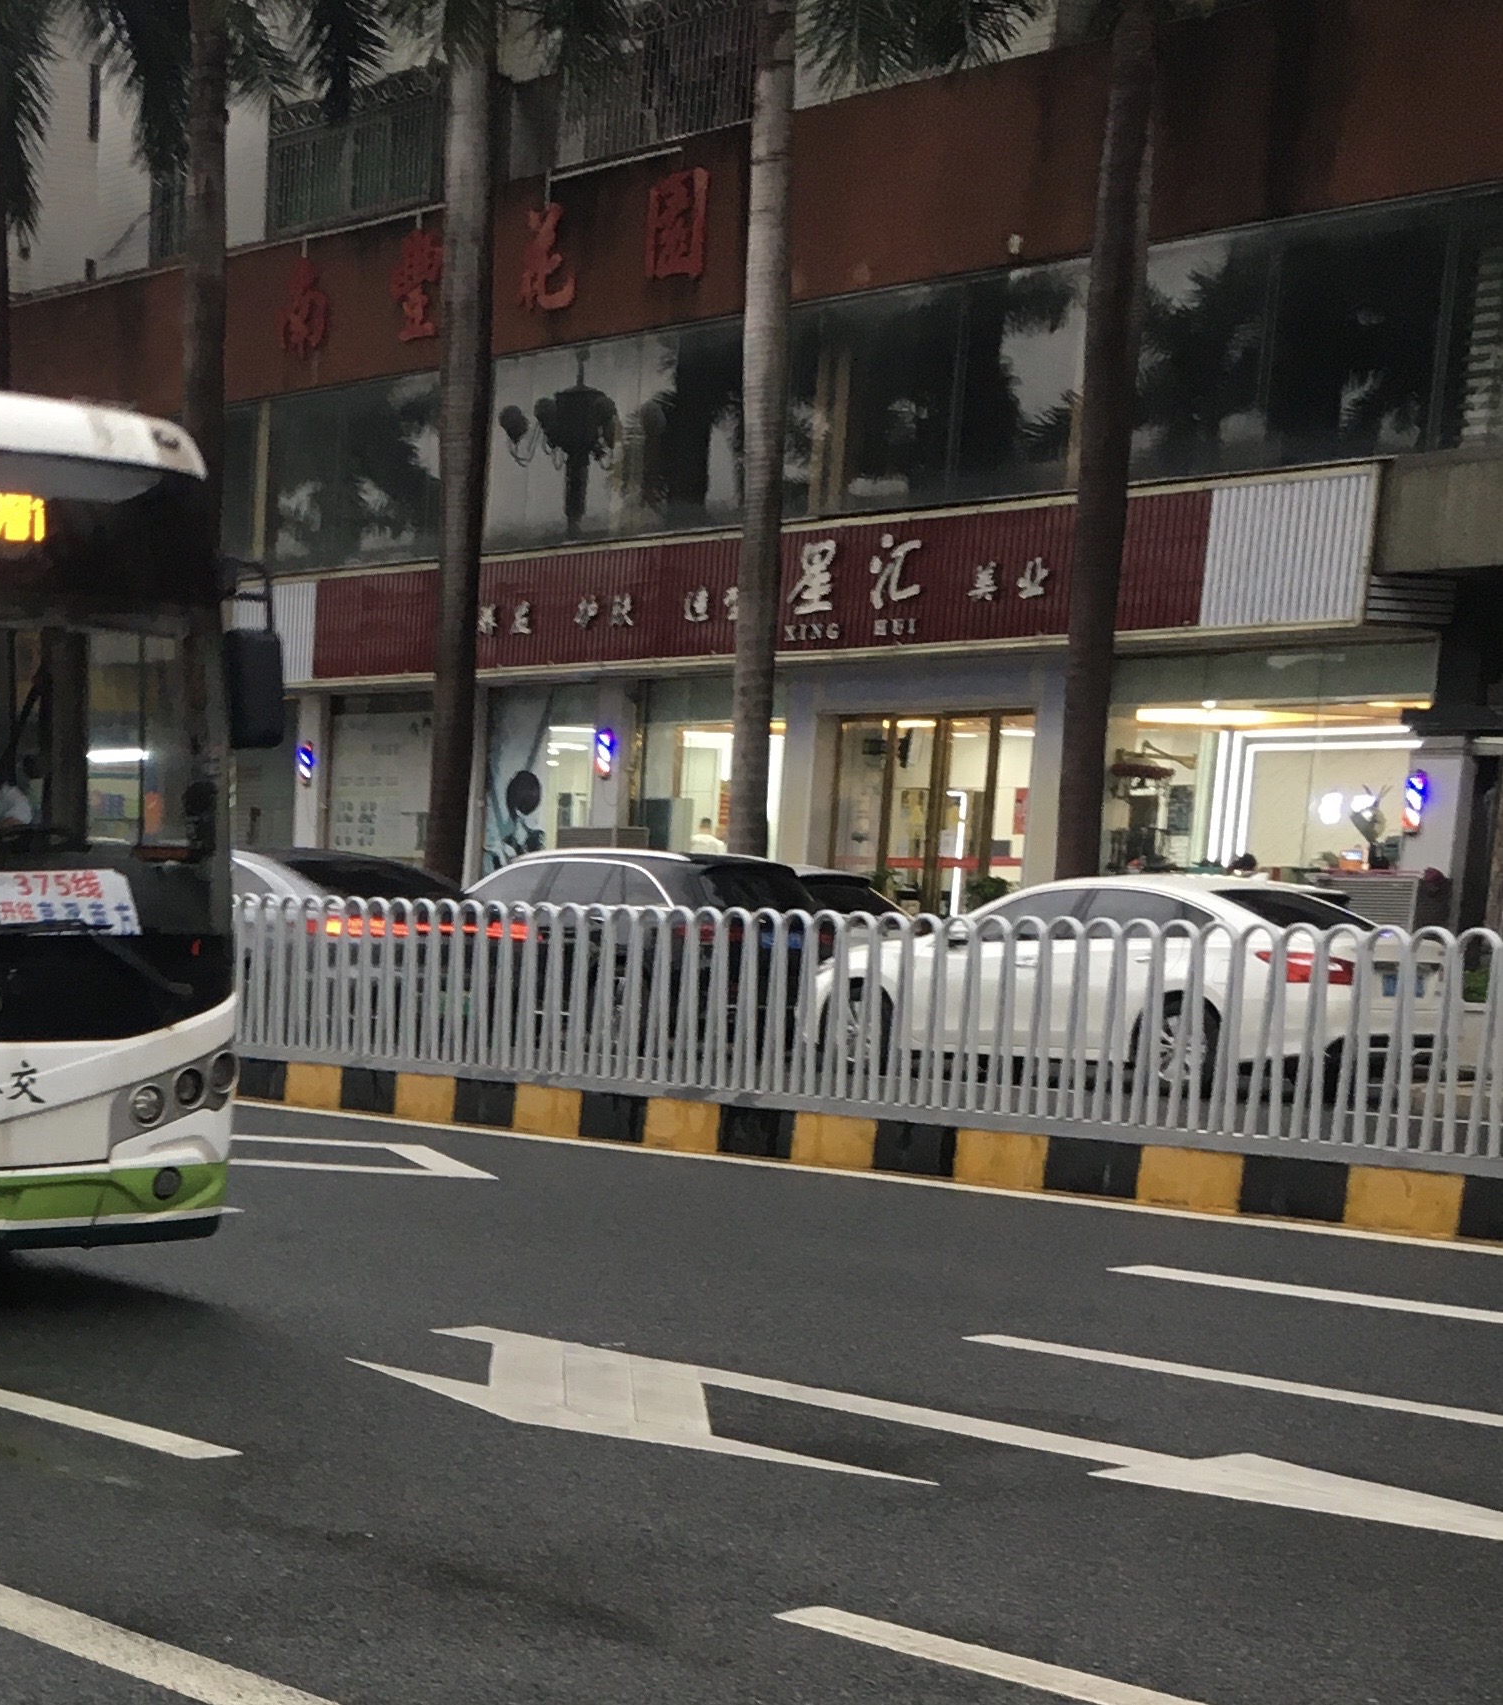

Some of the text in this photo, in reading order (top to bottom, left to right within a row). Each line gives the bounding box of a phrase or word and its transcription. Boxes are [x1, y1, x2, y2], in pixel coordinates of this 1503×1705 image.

[786, 533, 1050, 616] 星汇 美业
[783, 617, 917, 643] XING HUI
